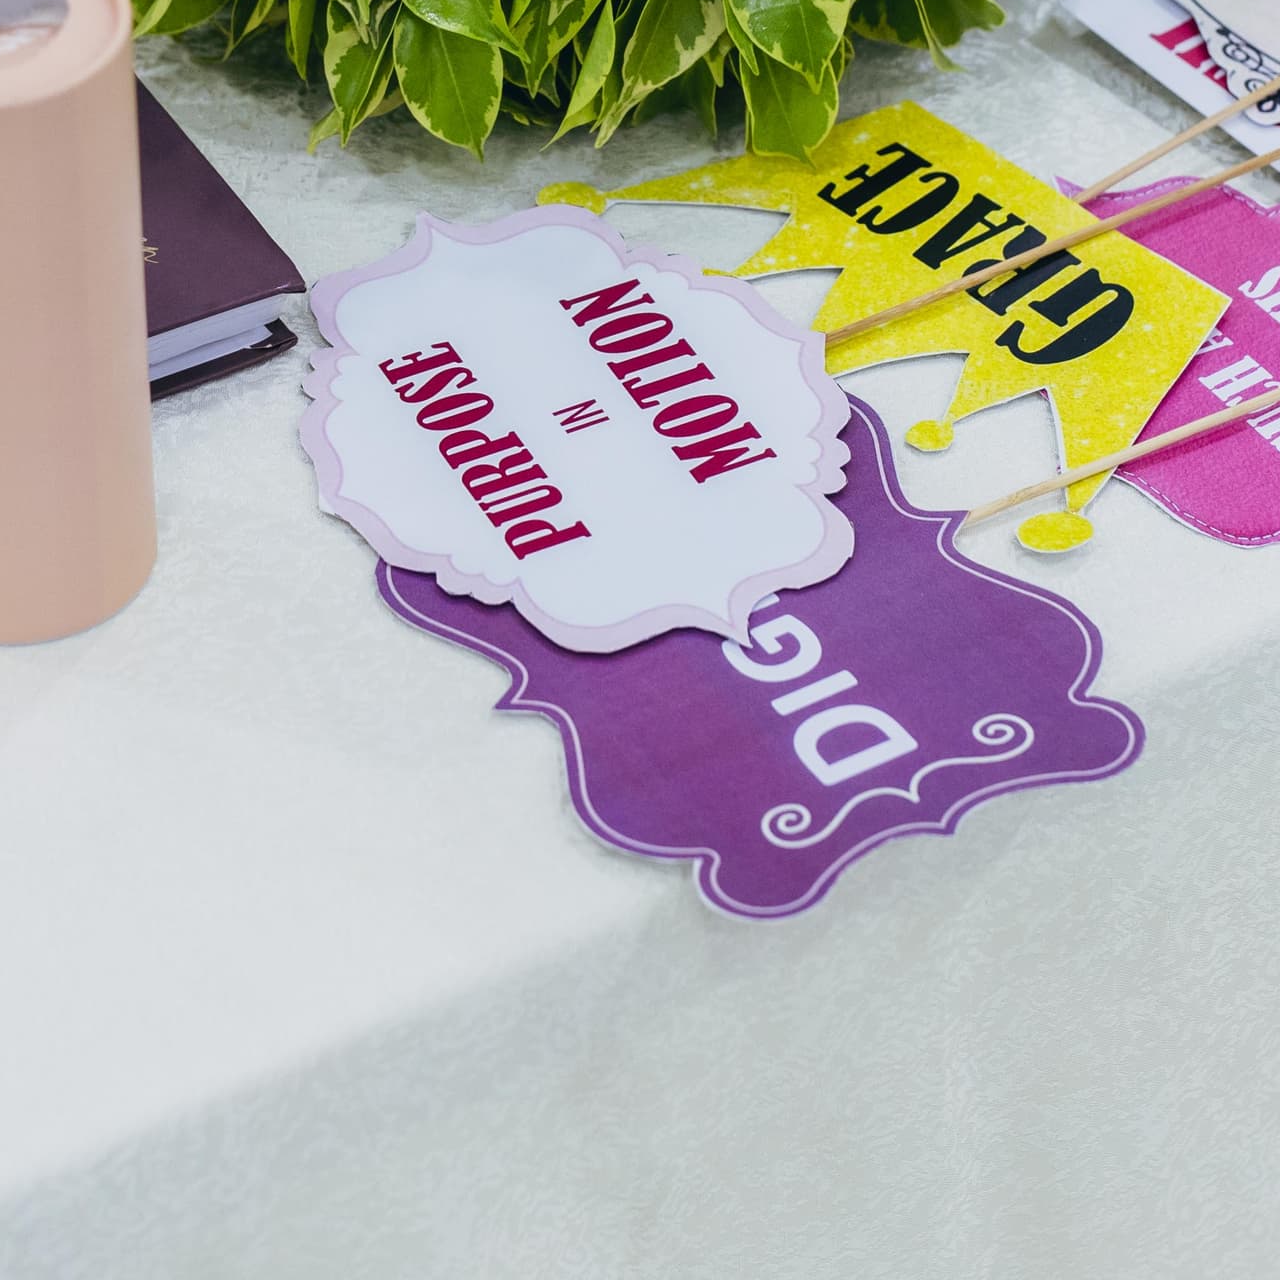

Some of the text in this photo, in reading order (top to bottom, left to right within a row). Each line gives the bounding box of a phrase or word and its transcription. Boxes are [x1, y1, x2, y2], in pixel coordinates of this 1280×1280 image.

[816, 141, 1136, 366] GRACE
[377, 341, 592, 561] PURPOSE
[552, 398, 610, 434] IN
[558, 278, 778, 485] MOTION
[720, 593, 920, 787] DIG
